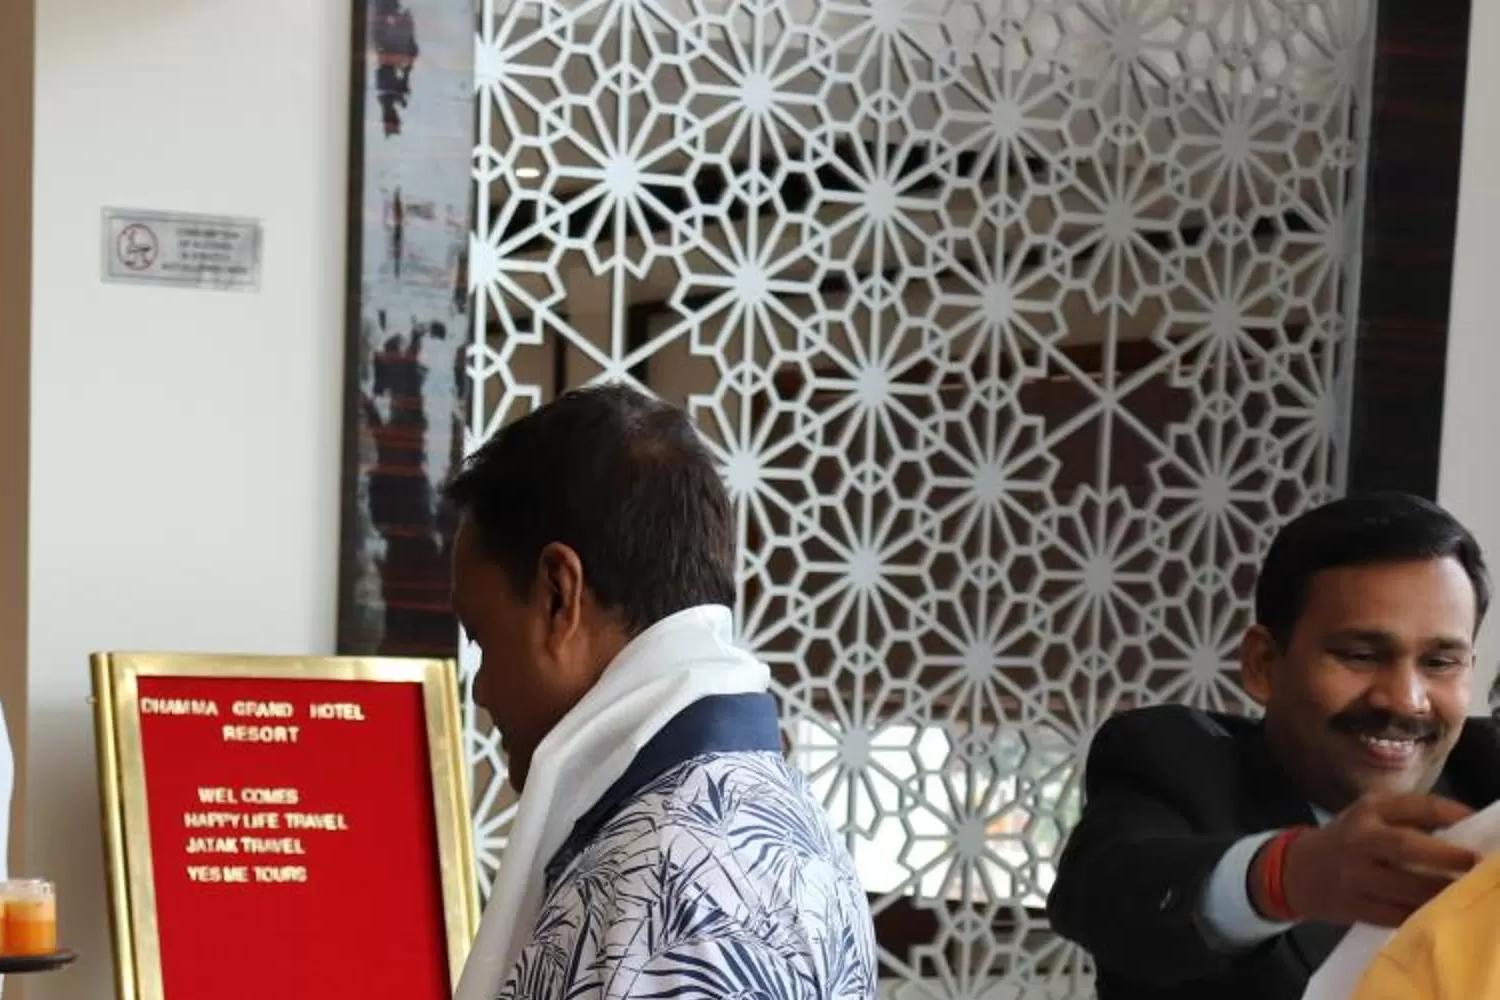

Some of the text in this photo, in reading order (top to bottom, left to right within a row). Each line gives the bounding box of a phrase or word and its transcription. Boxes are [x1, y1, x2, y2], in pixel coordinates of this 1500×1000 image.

[231, 700, 294, 718] GRAND
[309, 702, 365, 721] HOTEL
[222, 724, 299, 742] RESORT
[183, 811, 348, 831] HAPPY LIFE TRAVEL
[240, 836, 306, 855] TRAVEL
[253, 865, 308, 883] TOURS
